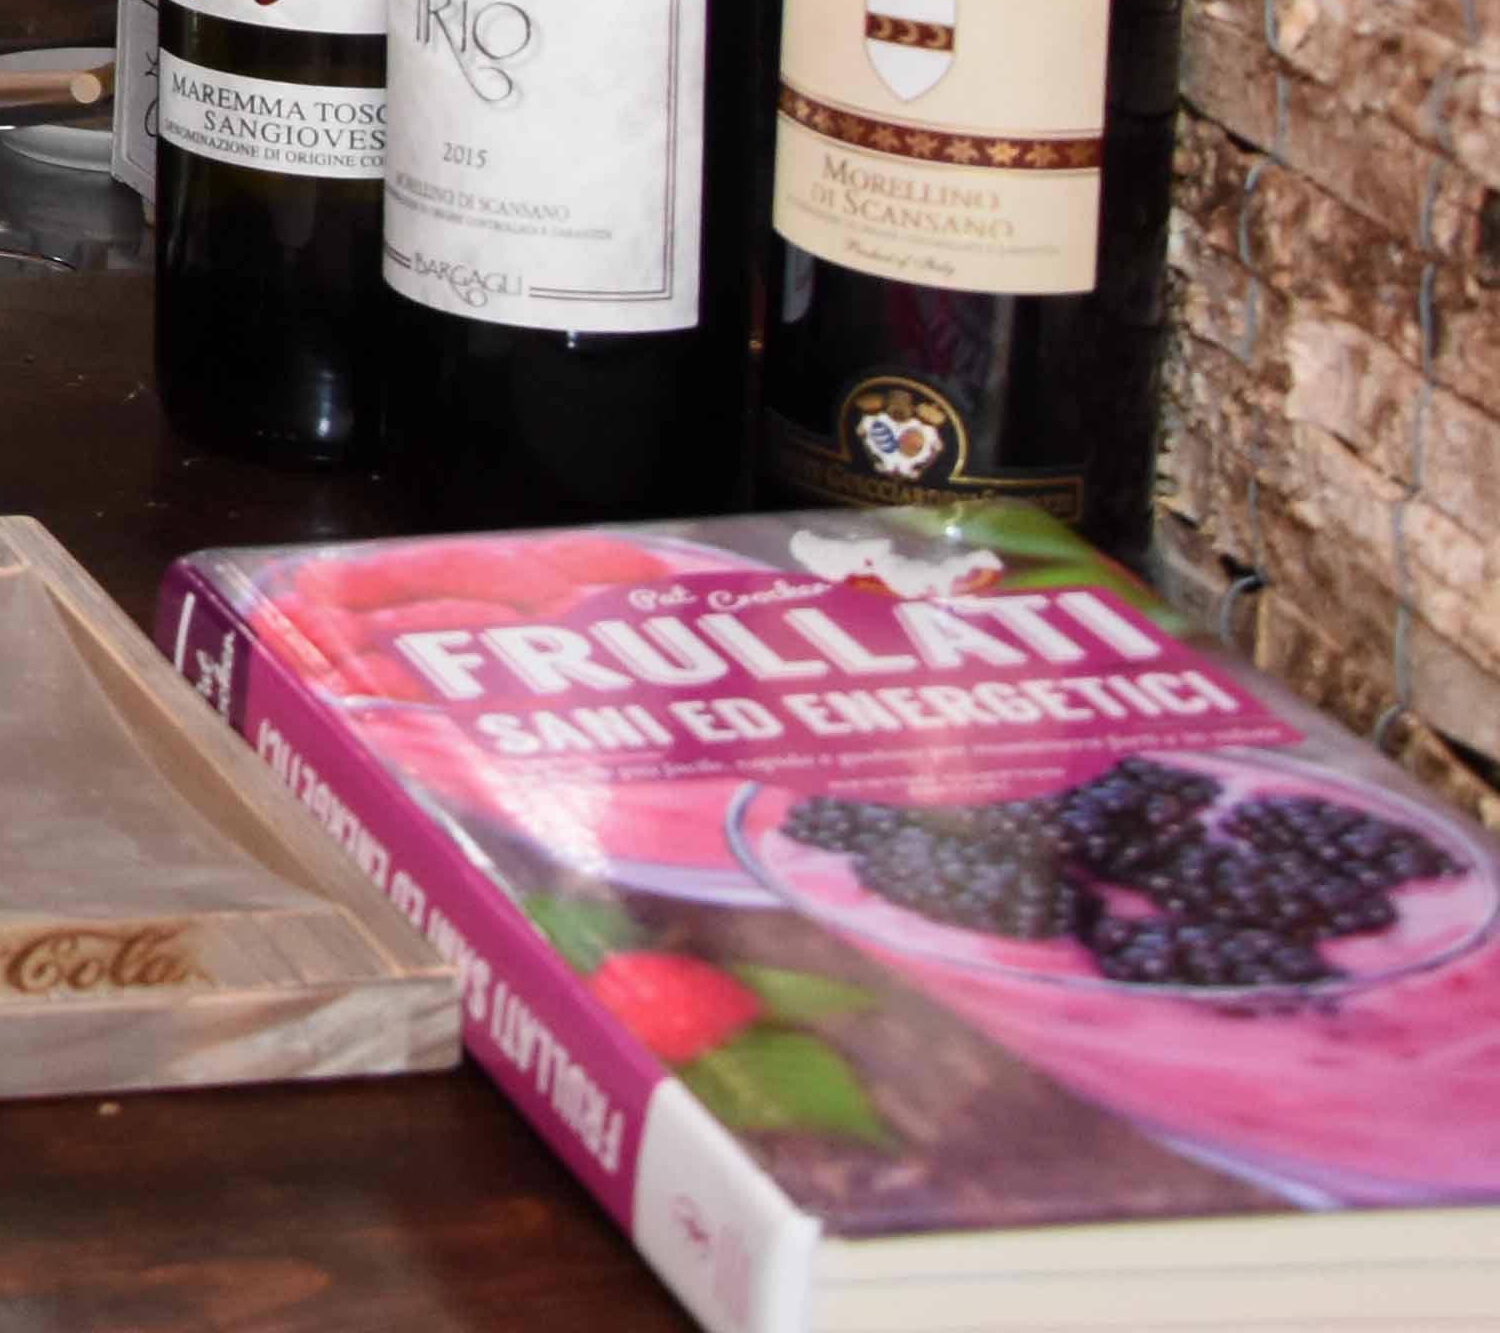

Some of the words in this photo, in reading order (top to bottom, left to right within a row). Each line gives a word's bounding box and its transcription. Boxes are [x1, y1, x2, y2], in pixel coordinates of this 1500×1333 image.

[171, 72, 306, 121] MAREMMA
[312, 101, 387, 125] TOSC
[203, 109, 386, 151] SANGIOVES
[263, 147, 281, 161] DI
[284, 151, 358, 168] ORIGINE
[442, 141, 489, 169] 2015
[413, 251, 524, 309] BARGAGLI
[393, 589, 1162, 702] FRULLATI
[476, 702, 676, 757] SANI
[668, 696, 786, 743] ED
[781, 669, 1242, 738] ENERGETICI
[491, 981, 627, 1175] FRULLATI
